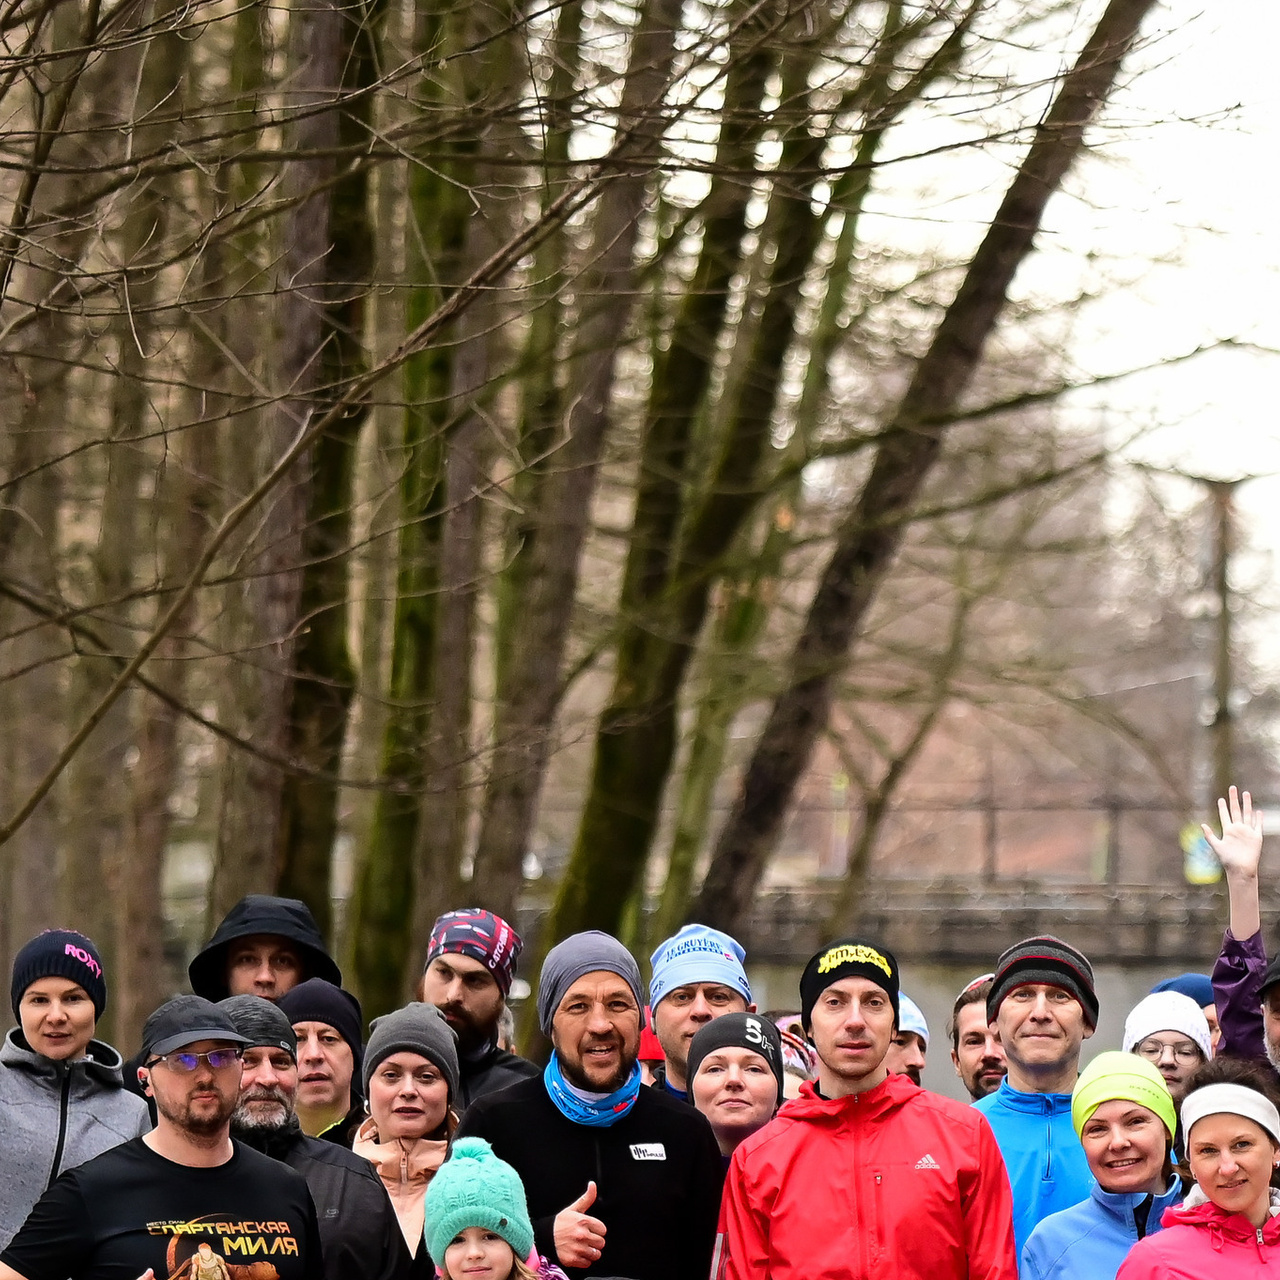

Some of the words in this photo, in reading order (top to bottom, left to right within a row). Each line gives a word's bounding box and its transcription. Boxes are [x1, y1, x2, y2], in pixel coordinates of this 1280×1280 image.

[64, 943, 102, 979] ROXY
[147, 1221, 291, 1236] СПАРТАНСКАЯ
[222, 1236, 299, 1257] МИЛЯ
